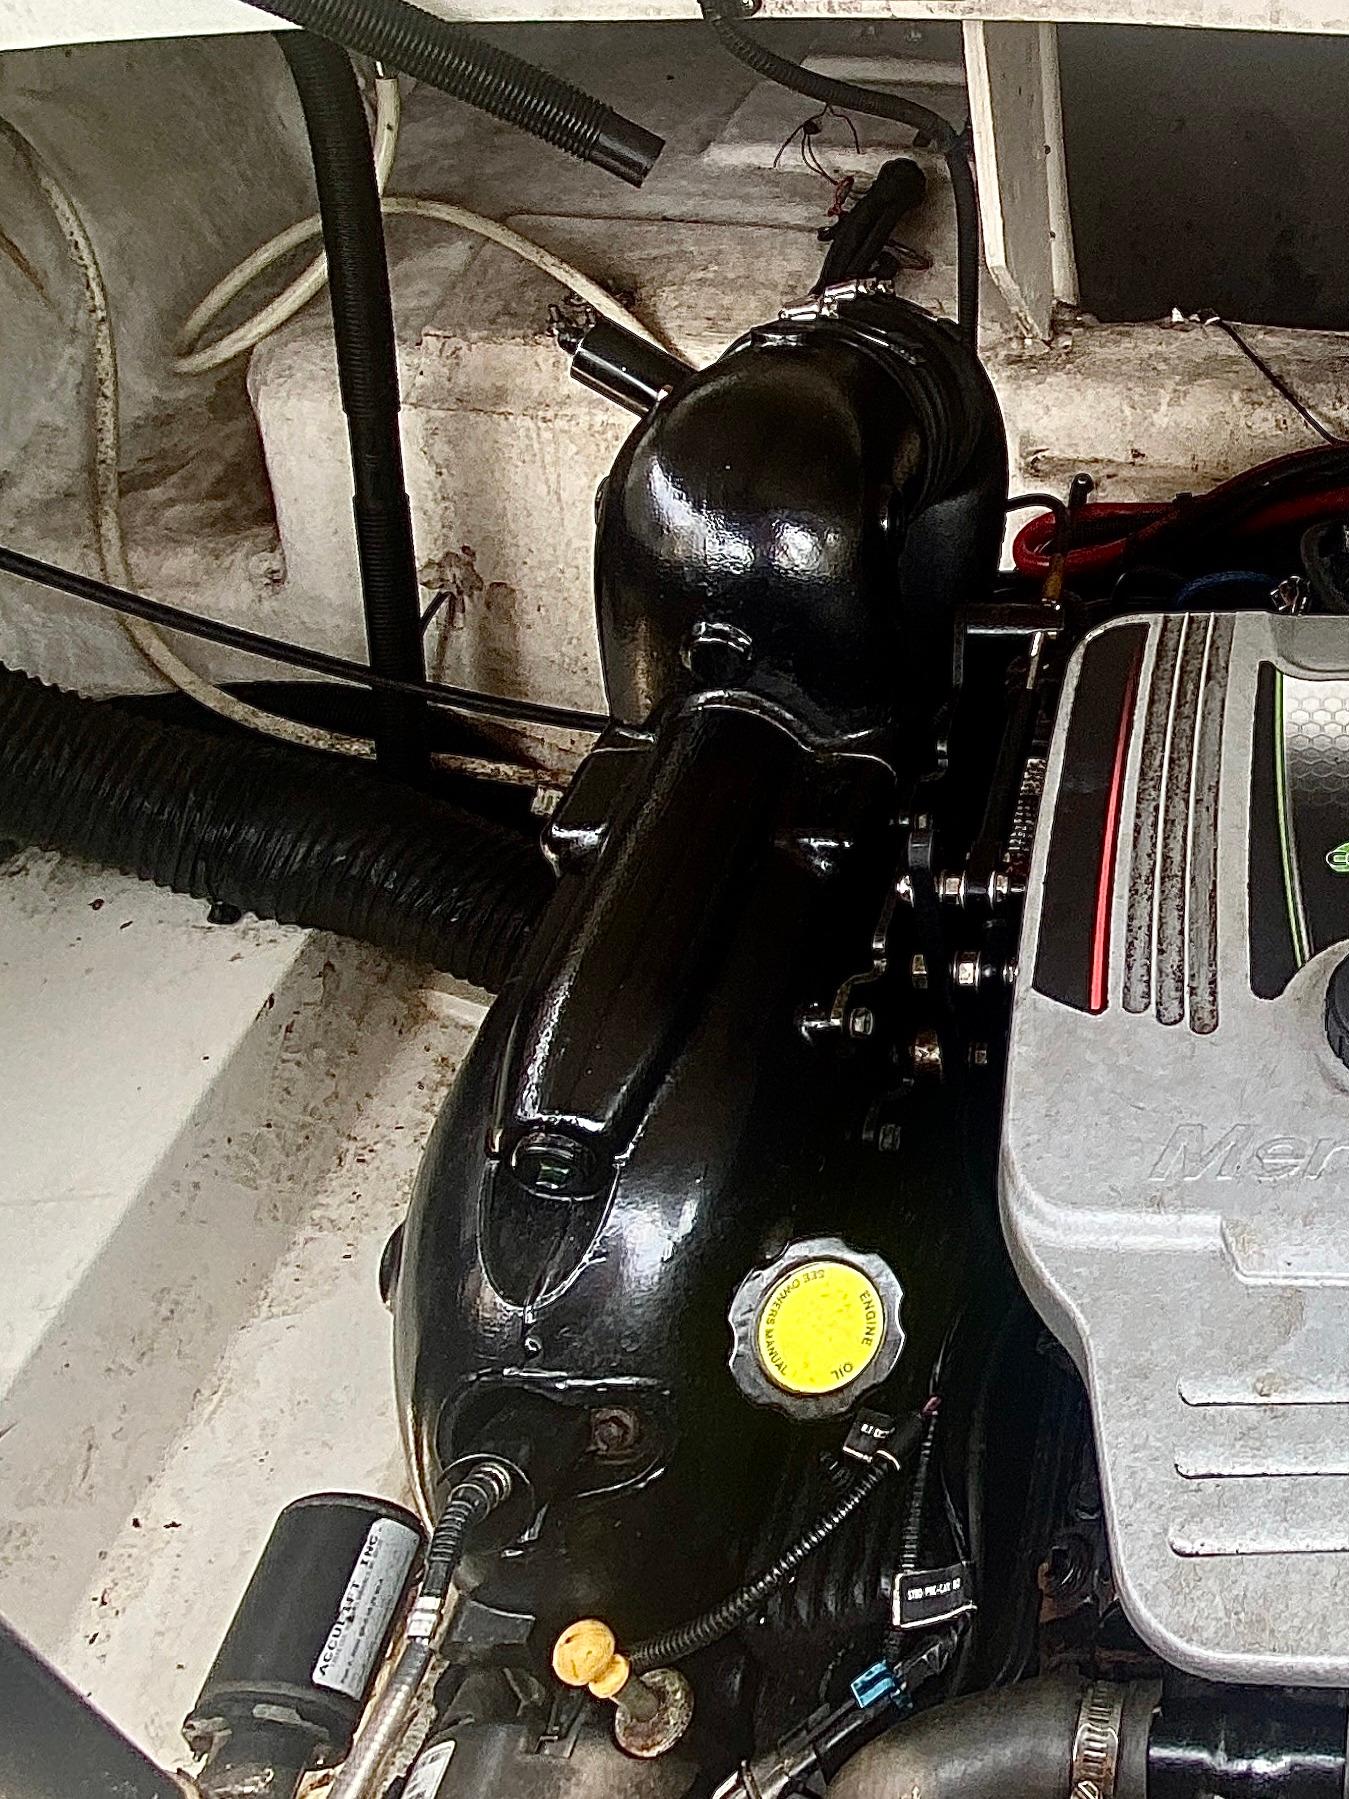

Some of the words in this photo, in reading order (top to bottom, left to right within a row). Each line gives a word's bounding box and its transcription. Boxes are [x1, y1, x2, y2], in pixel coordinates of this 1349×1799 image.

[802, 1268, 826, 1285] SEE
[766, 1278, 801, 1326] OWNERS
[858, 1289, 878, 1347] ENGINE
[764, 1328, 788, 1377] MANUAL
[830, 1361, 855, 1381] OIL
